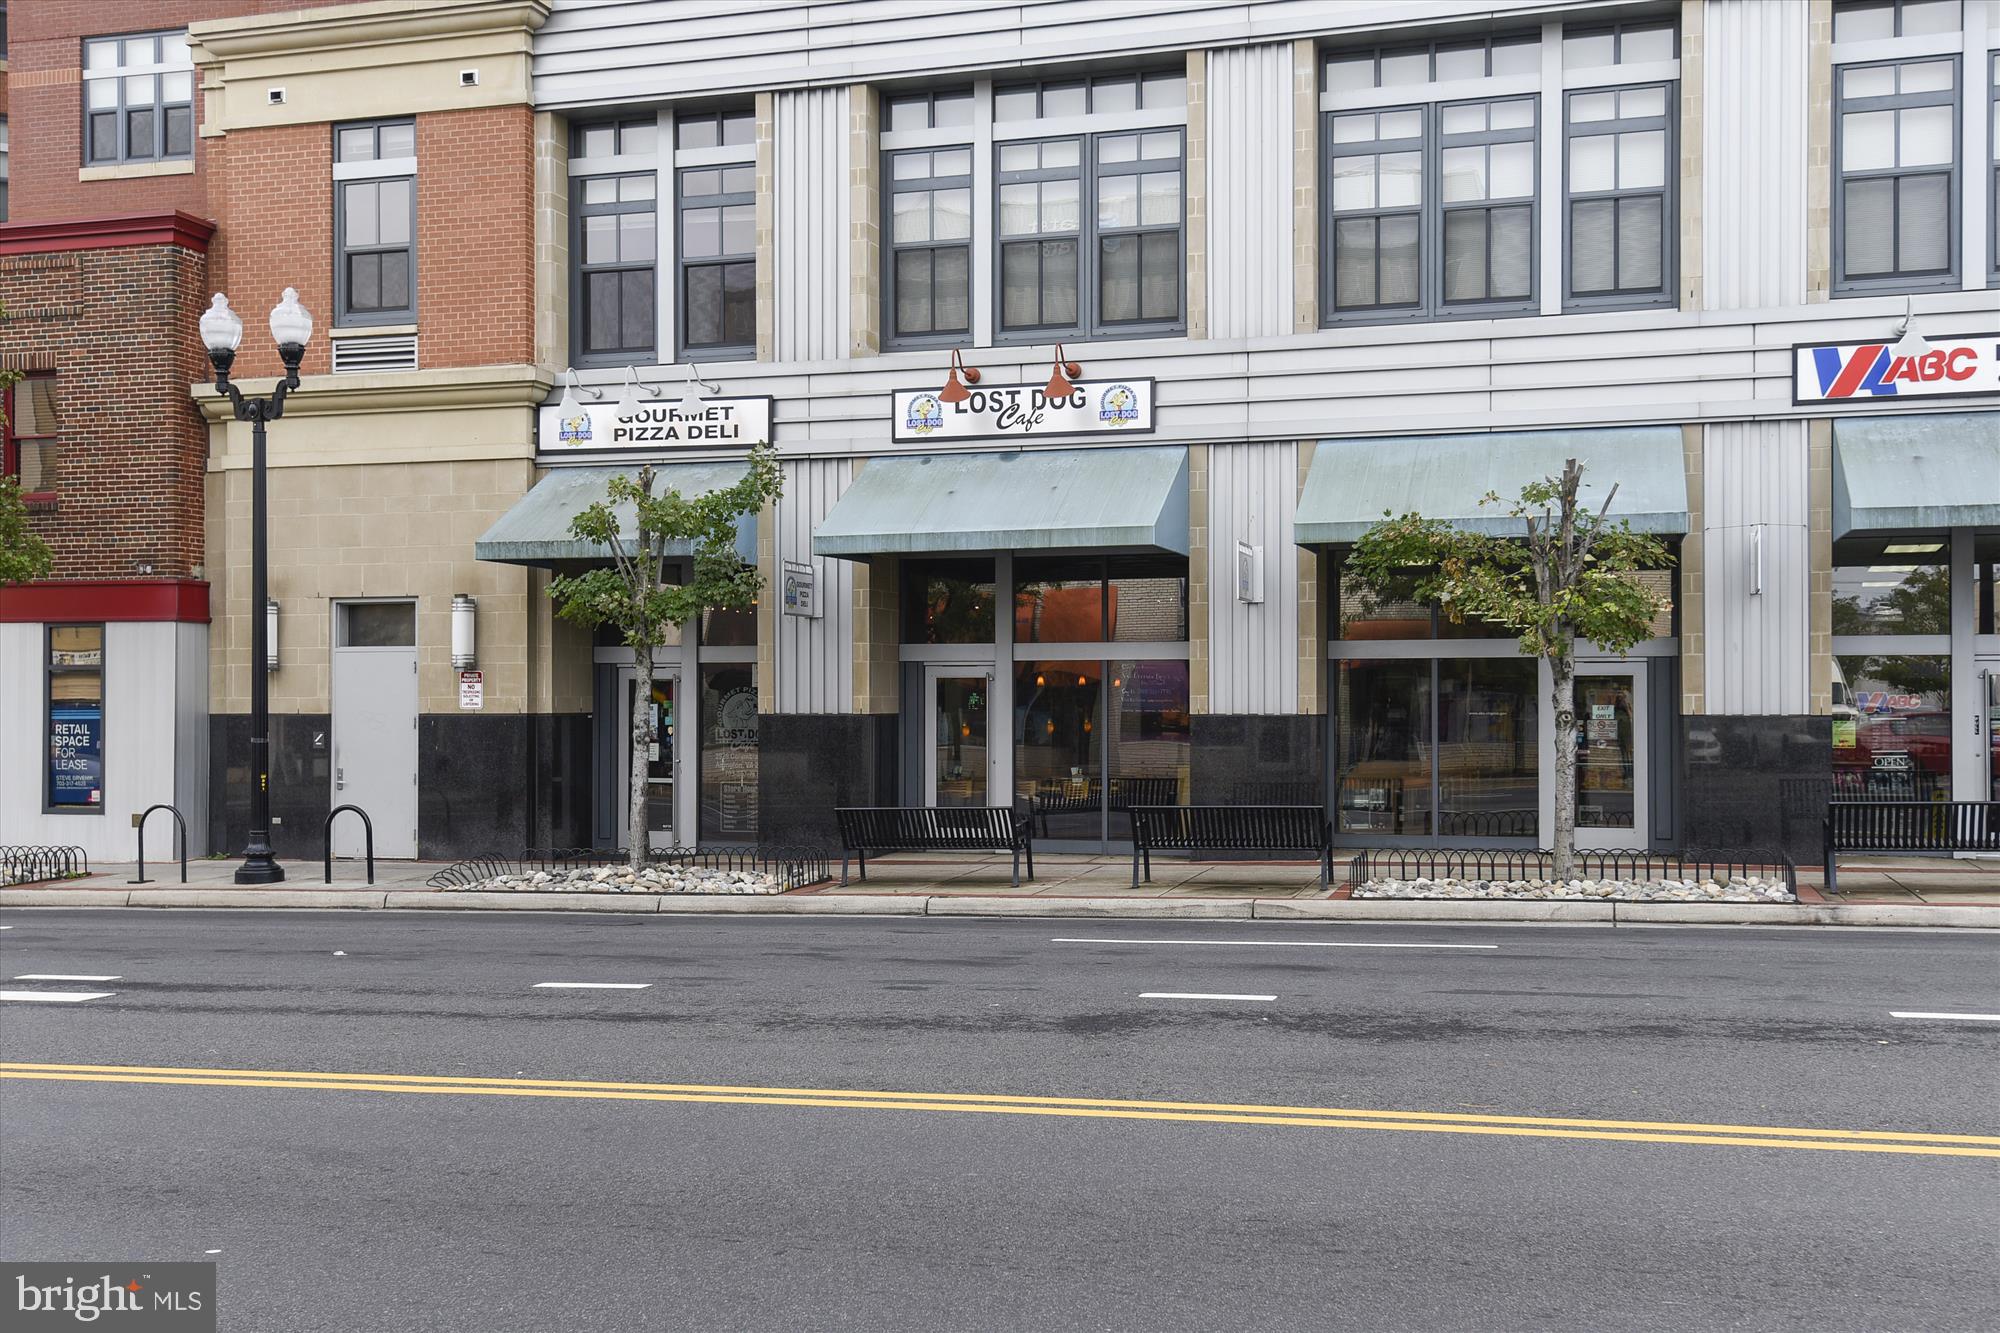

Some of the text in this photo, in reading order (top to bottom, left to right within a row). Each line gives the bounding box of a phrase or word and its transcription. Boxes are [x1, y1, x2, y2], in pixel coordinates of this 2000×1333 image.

[1881, 346, 1978, 384] ABC
[955, 387, 1087, 414] LOST DOG
[996, 403, 1044, 432] Cafe
[613, 424, 739, 442] PIZZA DELI
[1885, 694, 1921, 709] ABC
[55, 724, 91, 735] RETAIL
[55, 735, 90, 747] SPACE
[55, 747, 76, 759] FOR
[55, 759, 88, 770] LEASE
[1874, 757, 1905, 767] OPEN
